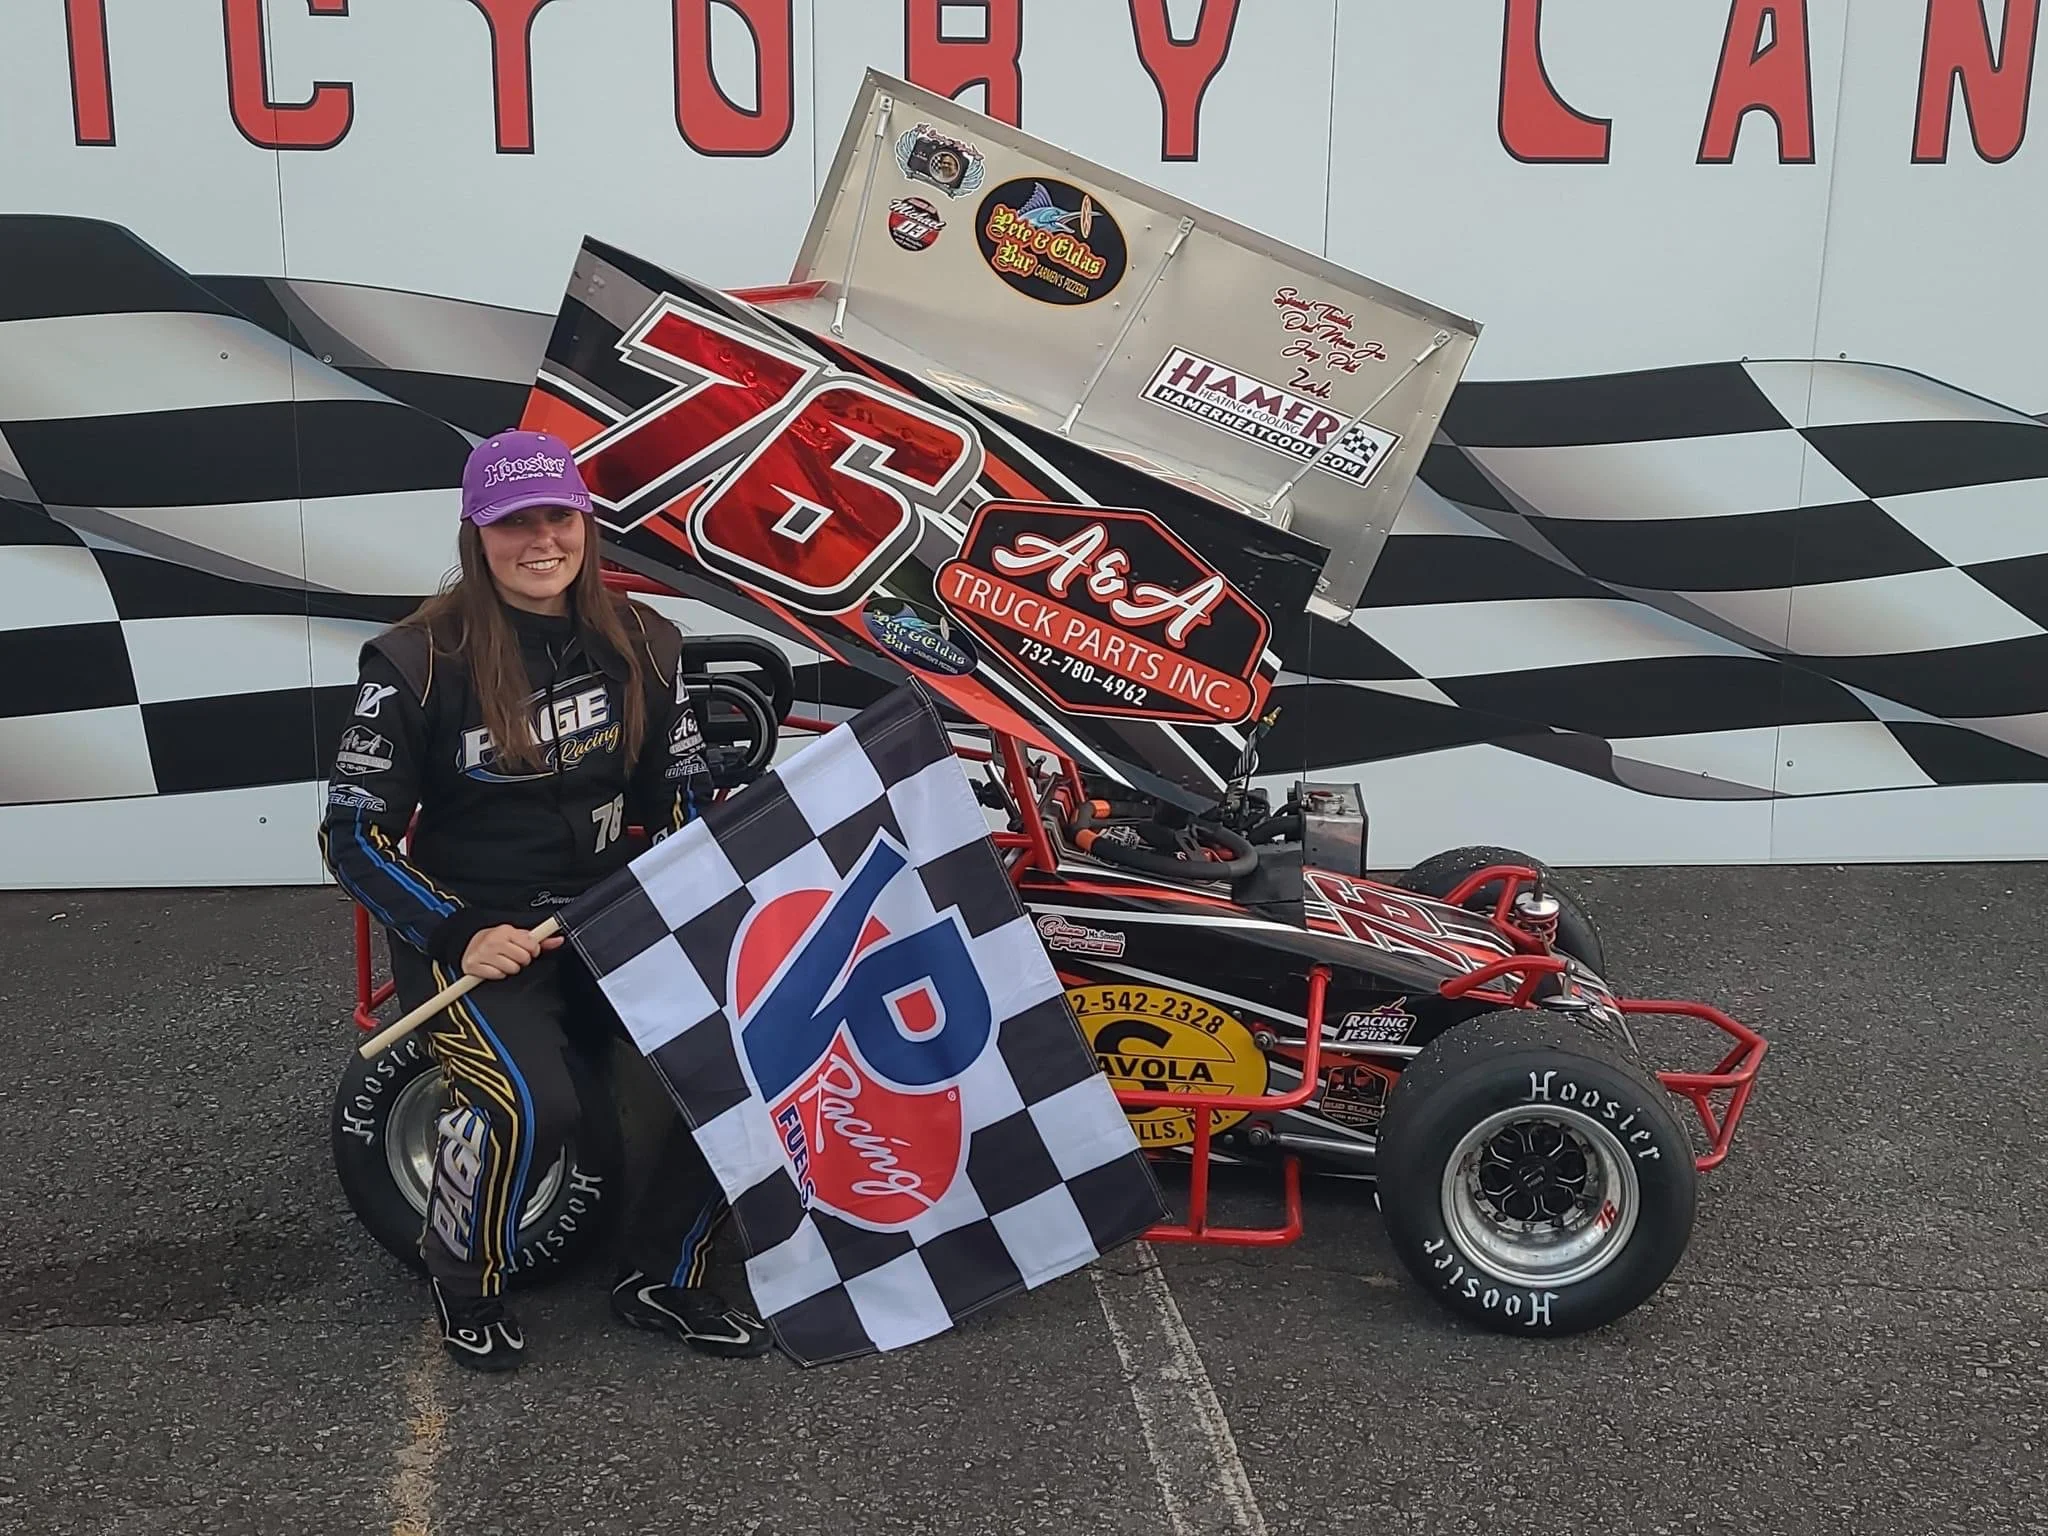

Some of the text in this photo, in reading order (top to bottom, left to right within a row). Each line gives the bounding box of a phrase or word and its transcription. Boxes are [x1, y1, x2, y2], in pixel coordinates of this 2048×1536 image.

[988, 206, 1102, 275] Pete & Eldas
[997, 240, 1034, 272] Bar
[1033, 263, 1089, 300] CARMEN'S PIZZERIA
[1167, 356, 1341, 446] HAMER
[1198, 388, 1300, 437] HEATING COOLING
[1288, 366, 1332, 399] Zak
[1157, 387, 1362, 476] HAMERHEATCOOLCOM
[483, 452, 566, 488] Hoosier
[992, 522, 1228, 648] A&A
[871, 603, 966, 666] Pete & Eldas
[881, 630, 912, 653] Bar
[952, 568, 1232, 713] TRUCK PARTS INC.
[1017, 637, 1150, 707] 732-780-4962
[461, 685, 611, 773] PGE
[545, 722, 621, 774] Racing
[1342, 1029, 1389, 1042] JESUS
[1345, 1015, 1409, 1029] RACING
[341, 1040, 420, 1146] Hoosie
[1528, 1070, 1662, 1161] Hoosier
[778, 1103, 816, 1209] FUELS
[799, 1053, 939, 1209] Racing
[1131, 1119, 1184, 1141] LLS,
[434, 1104, 488, 1264] PAGE
[506, 1163, 604, 1274] Hoosier
[1423, 1238, 1559, 1328] Hoosier
